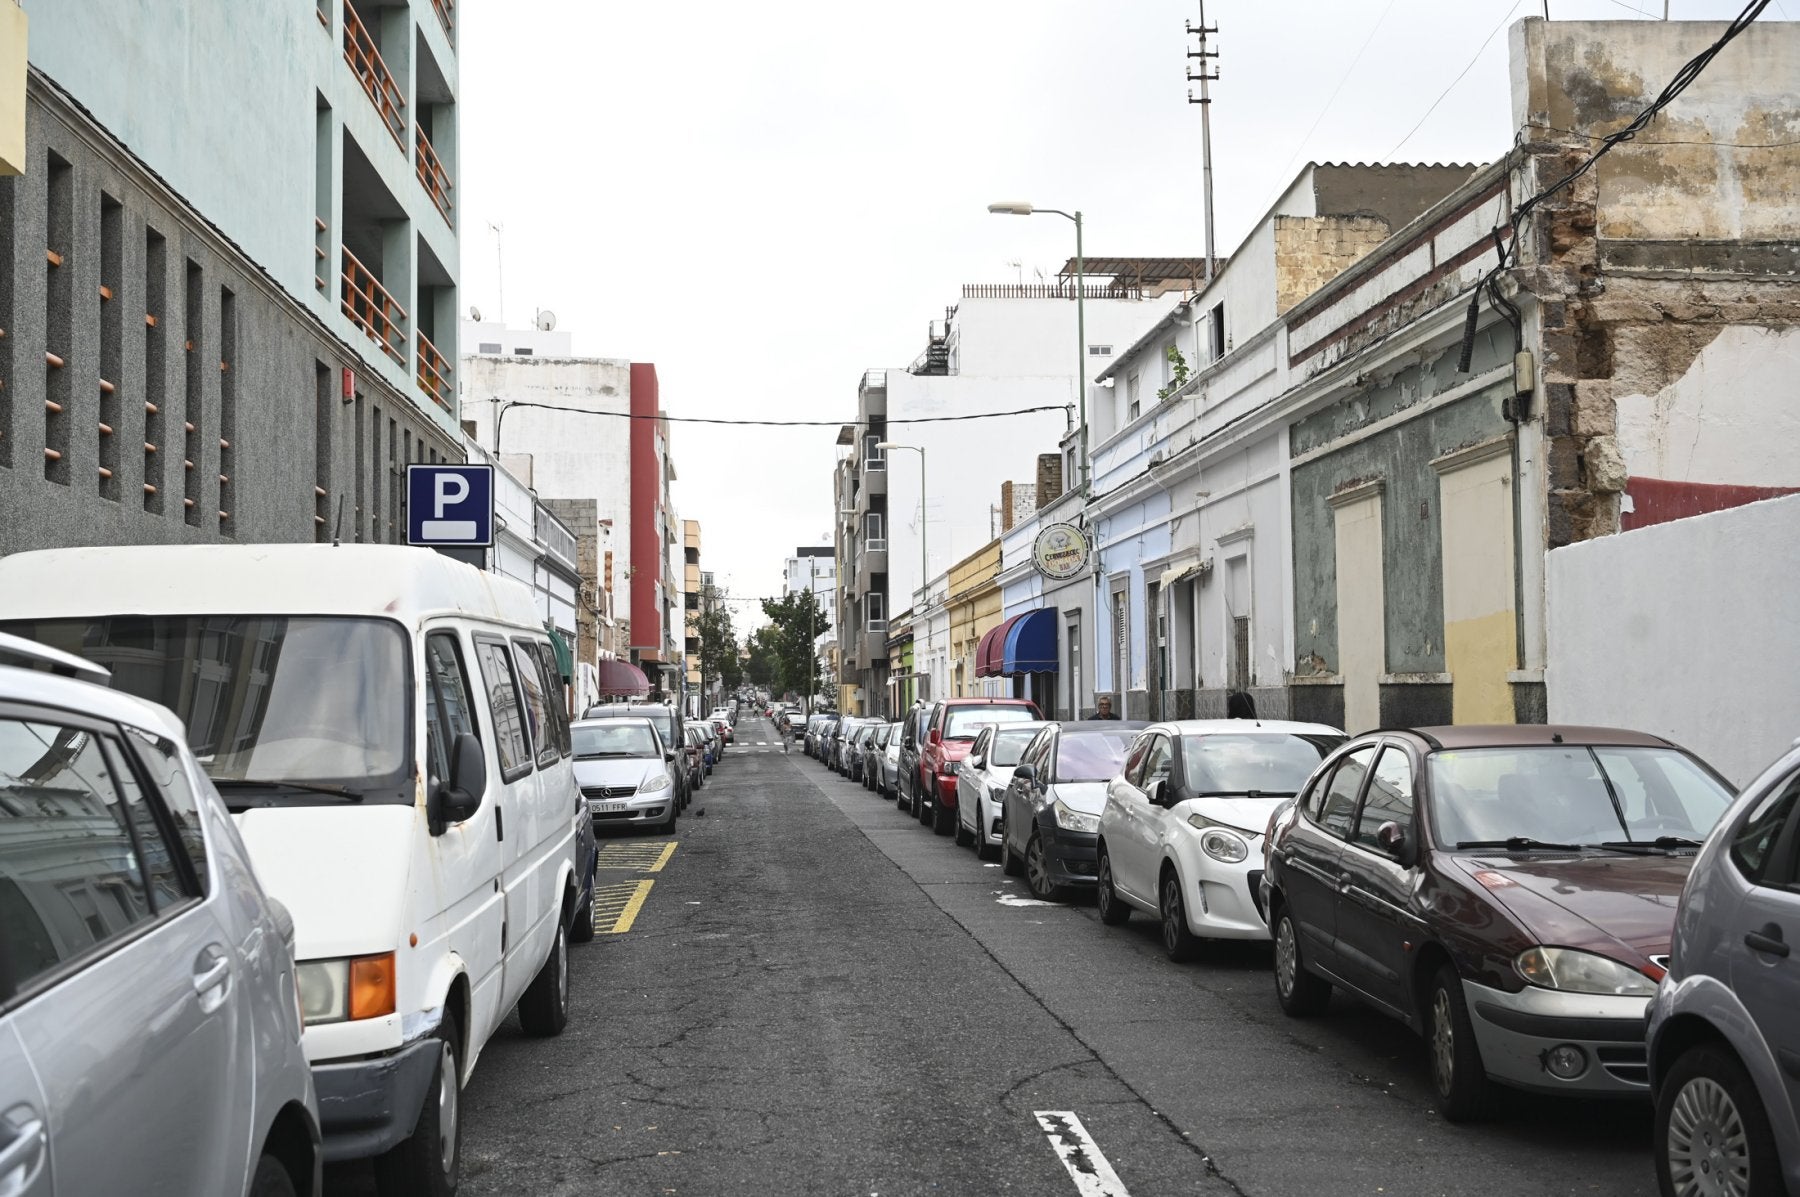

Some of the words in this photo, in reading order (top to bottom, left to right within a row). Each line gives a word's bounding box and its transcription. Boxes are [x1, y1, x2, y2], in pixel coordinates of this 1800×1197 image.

[434, 472, 470, 518] P
[591, 804, 609, 812] 0511
[612, 803, 626, 811] FFR
